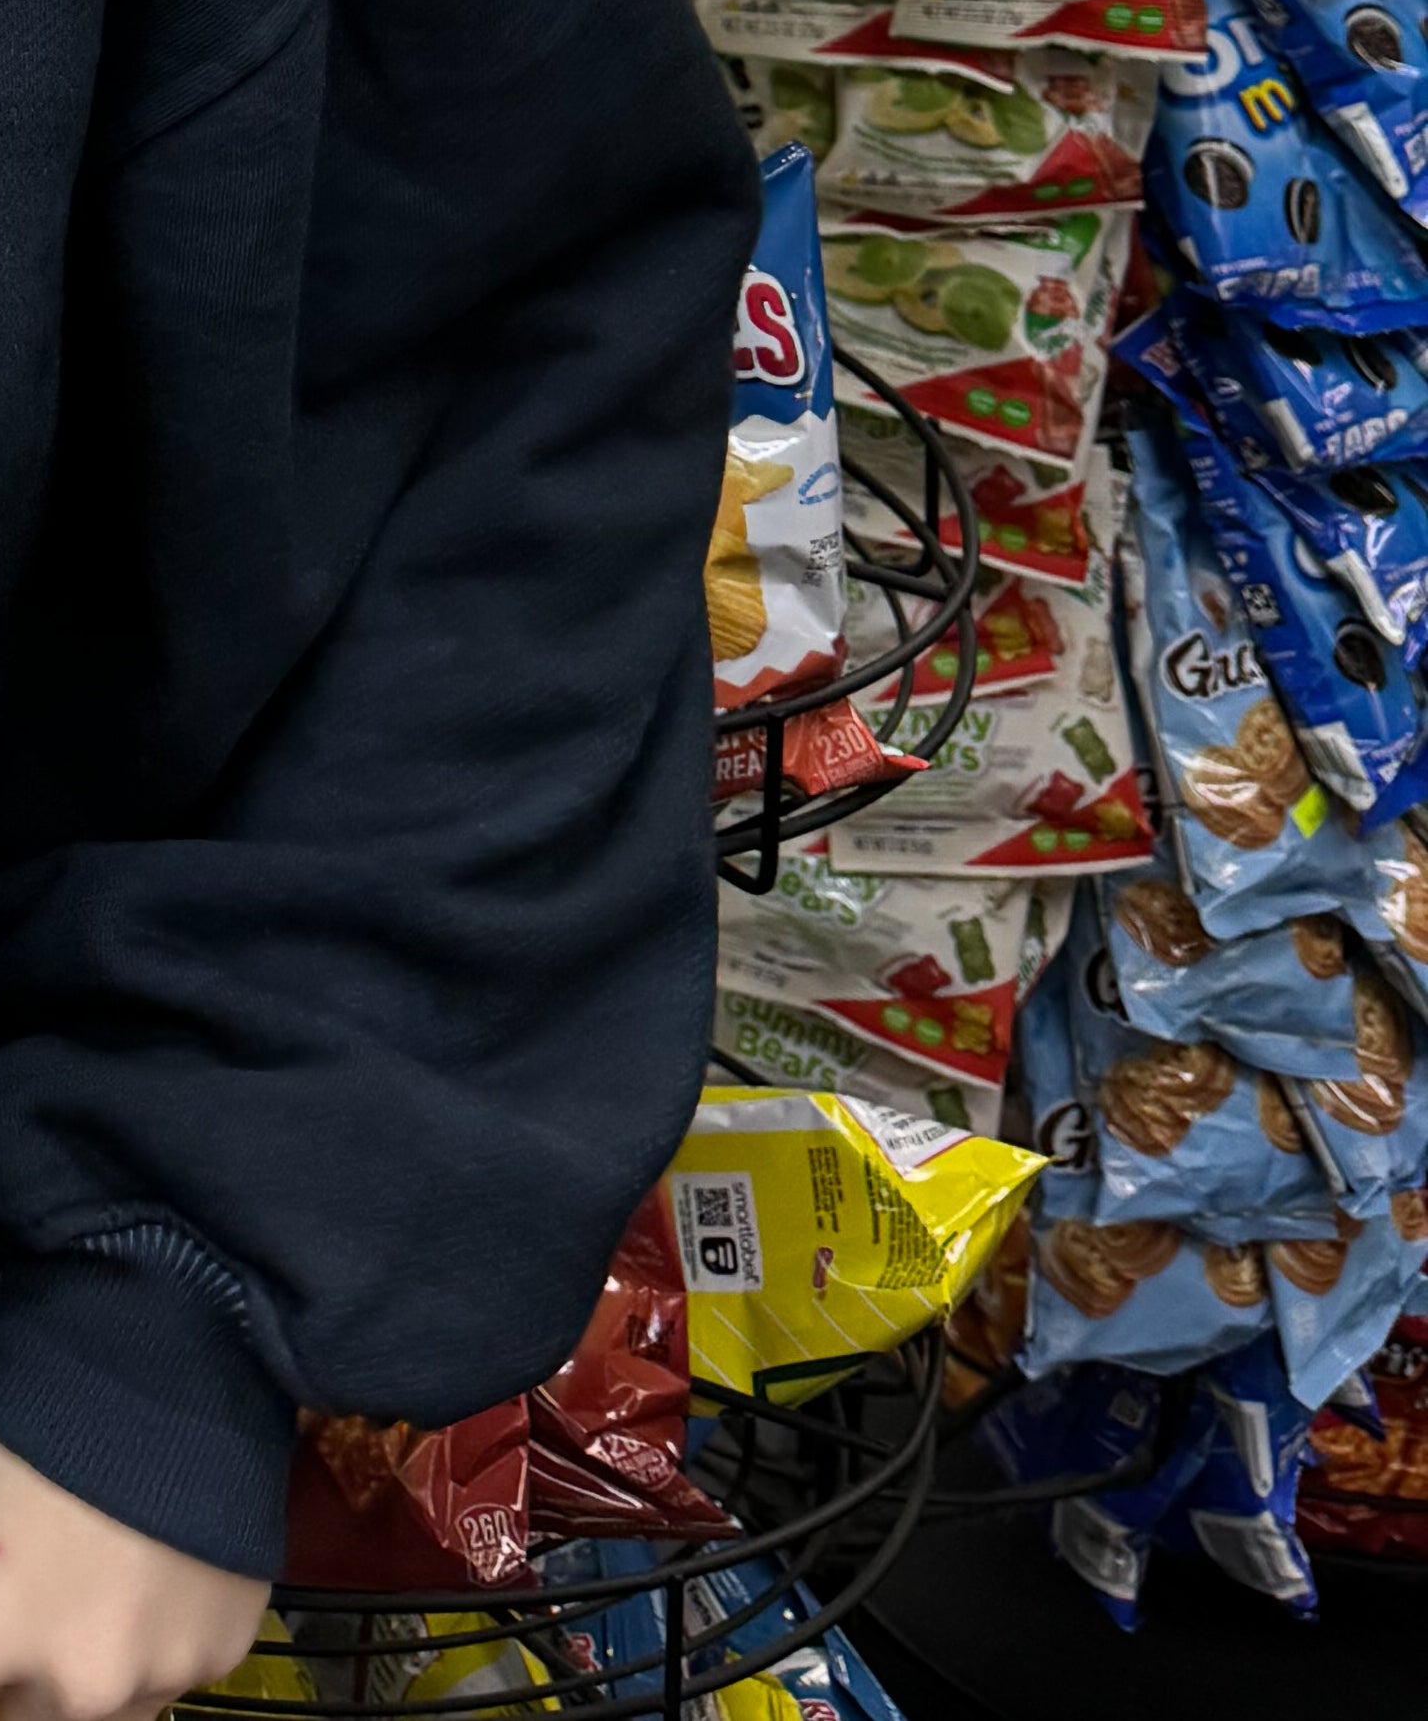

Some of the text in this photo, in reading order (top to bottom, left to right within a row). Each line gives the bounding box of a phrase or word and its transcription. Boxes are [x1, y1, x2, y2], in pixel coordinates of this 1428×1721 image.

[820, 721, 868, 767] 230
[723, 991, 866, 1067] Gummy
[736, 1024, 838, 1093] Bears
[731, 1181, 761, 1286] smartlabel
